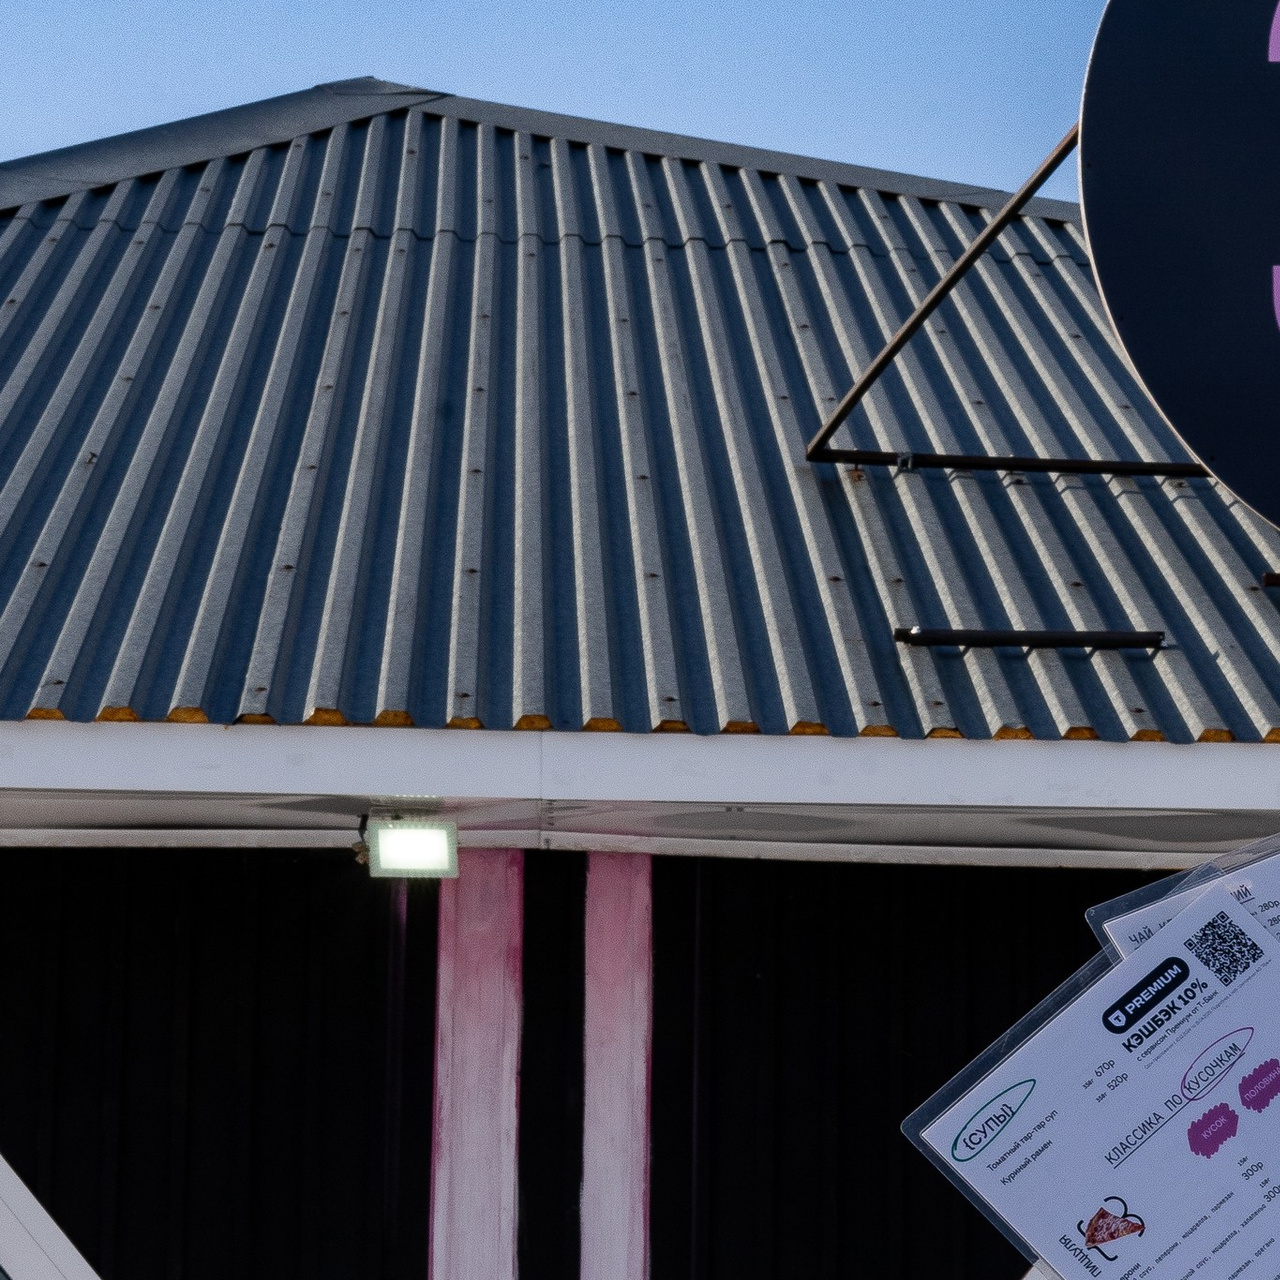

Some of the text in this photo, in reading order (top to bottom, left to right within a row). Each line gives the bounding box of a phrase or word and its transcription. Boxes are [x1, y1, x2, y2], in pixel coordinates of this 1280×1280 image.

[1257, 899, 1280, 913] 280р
[1124, 962, 1182, 1016] PREMIUM
[1121, 977, 1209, 1053] КЭШБЭК 10%
[1140, 1033, 1168, 1058] сервисом
[1196, 989, 1219, 1008] Т-Банк
[1094, 1059, 1116, 1078] 670р
[1106, 1072, 1129, 1091] 520р
[962, 1103, 1017, 1151] {СУПЫ}
[1104, 1042, 1243, 1165] КЛАССИКА ПО КУСОЧКАМ
[1201, 1114, 1227, 1139] КУСОК
[986, 1109, 1059, 1171] Томатный тар-тар суп
[1000, 1139, 1053, 1186] Куриный рамен
[1241, 1161, 1264, 1181] 300р
[1058, 1234, 1102, 1278] ПИЦЦУЛЯ
